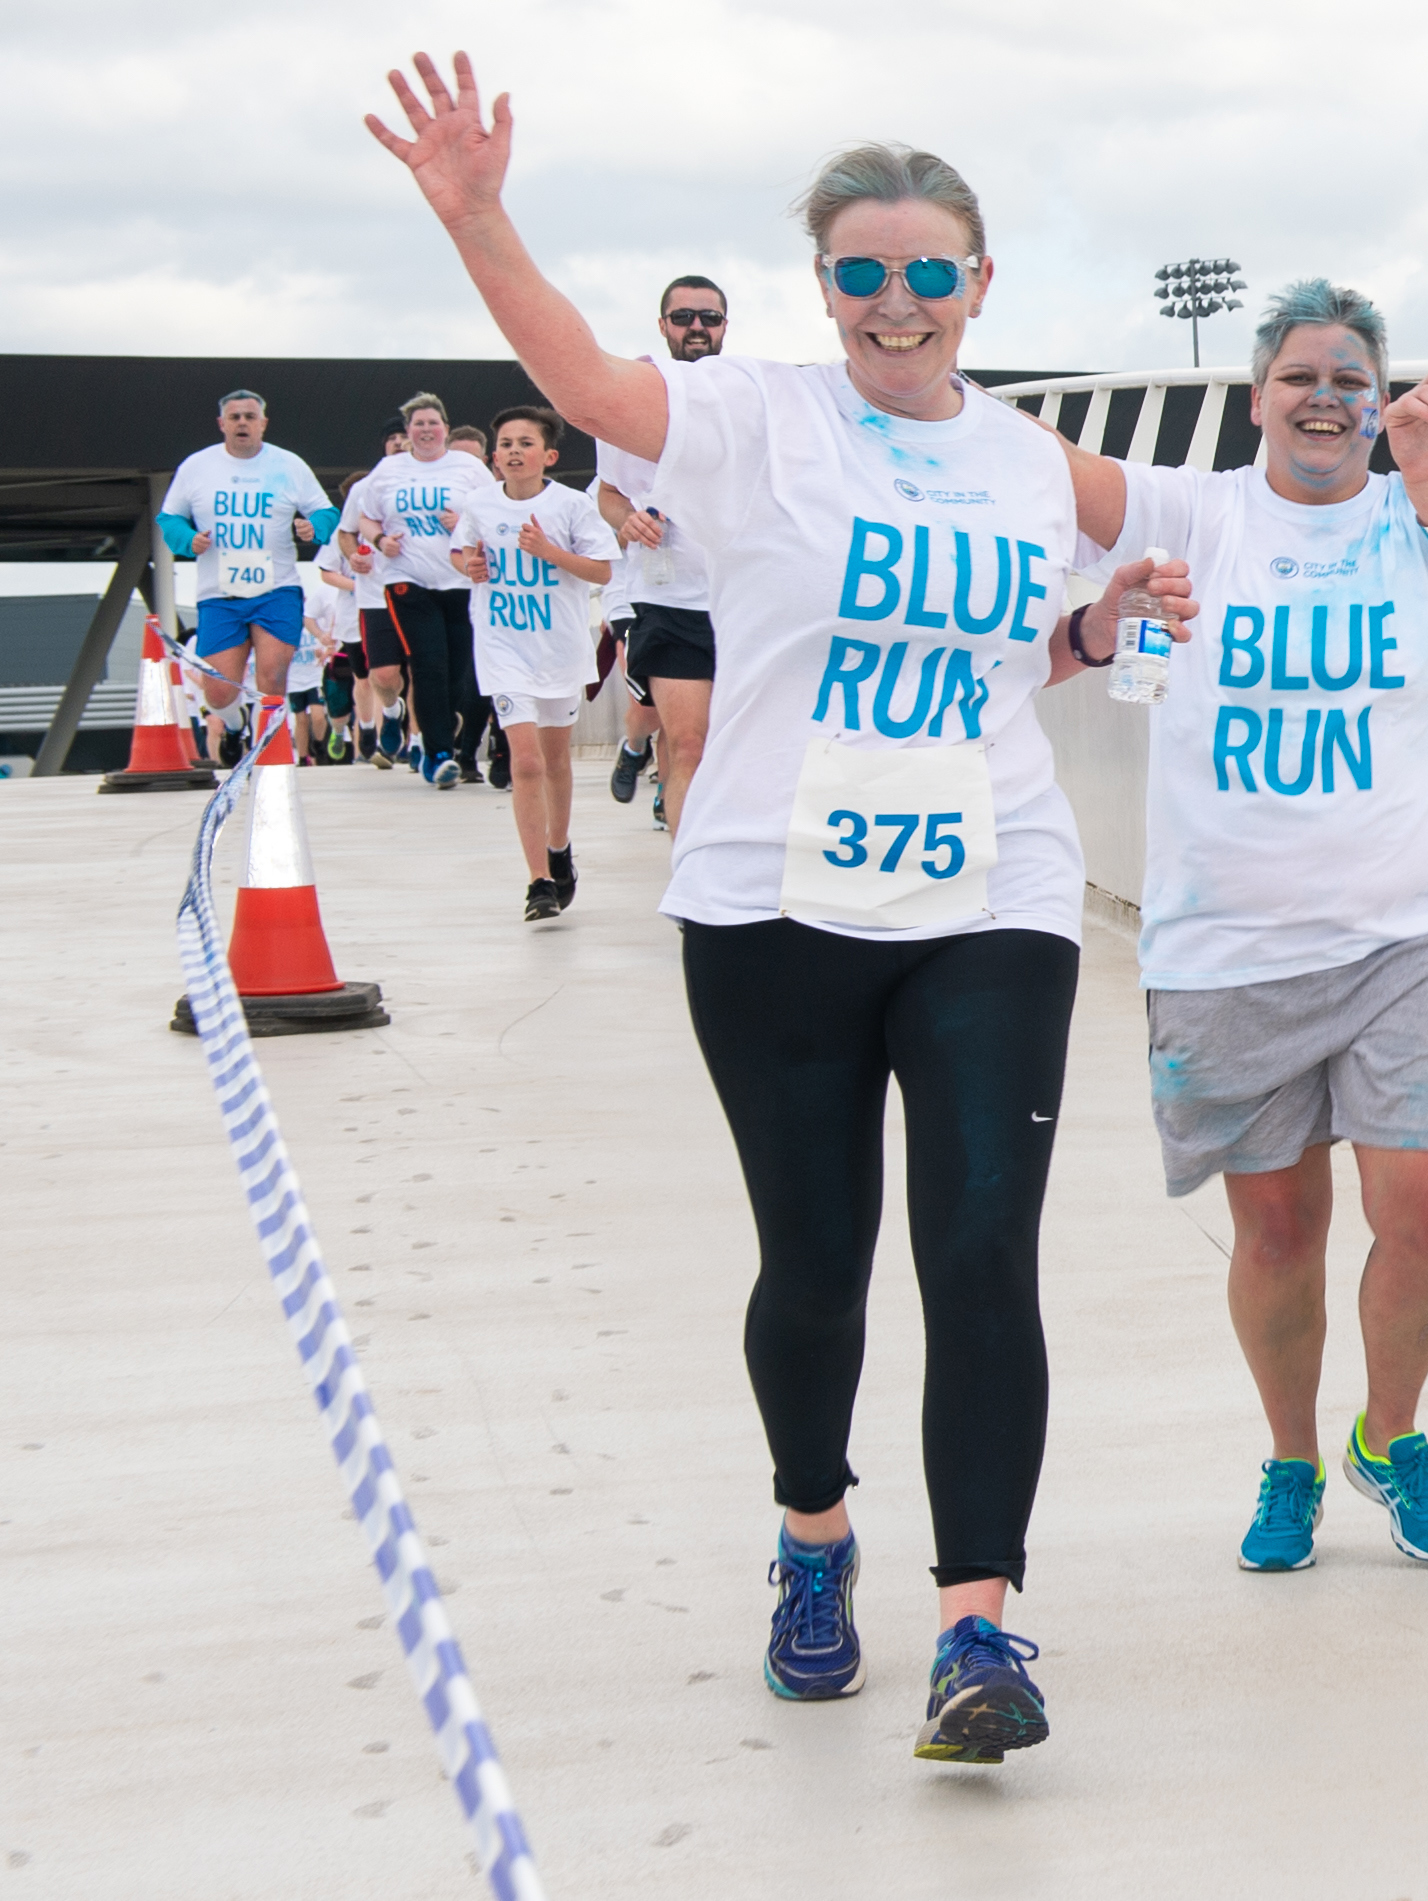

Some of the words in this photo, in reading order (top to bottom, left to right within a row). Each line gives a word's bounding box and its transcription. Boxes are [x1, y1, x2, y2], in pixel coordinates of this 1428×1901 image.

[214, 490, 274, 518] BLUE
[396, 486, 451, 513] BLUE
[215, 522, 264, 549] RUN
[228, 566, 265, 584] 740
[838, 516, 1047, 643] BLUE
[489, 590, 552, 632] RUN
[1219, 601, 1405, 691] BLUE
[812, 636, 1002, 740] RUN
[1212, 705, 1373, 796] RUN
[822, 810, 966, 880] 375
